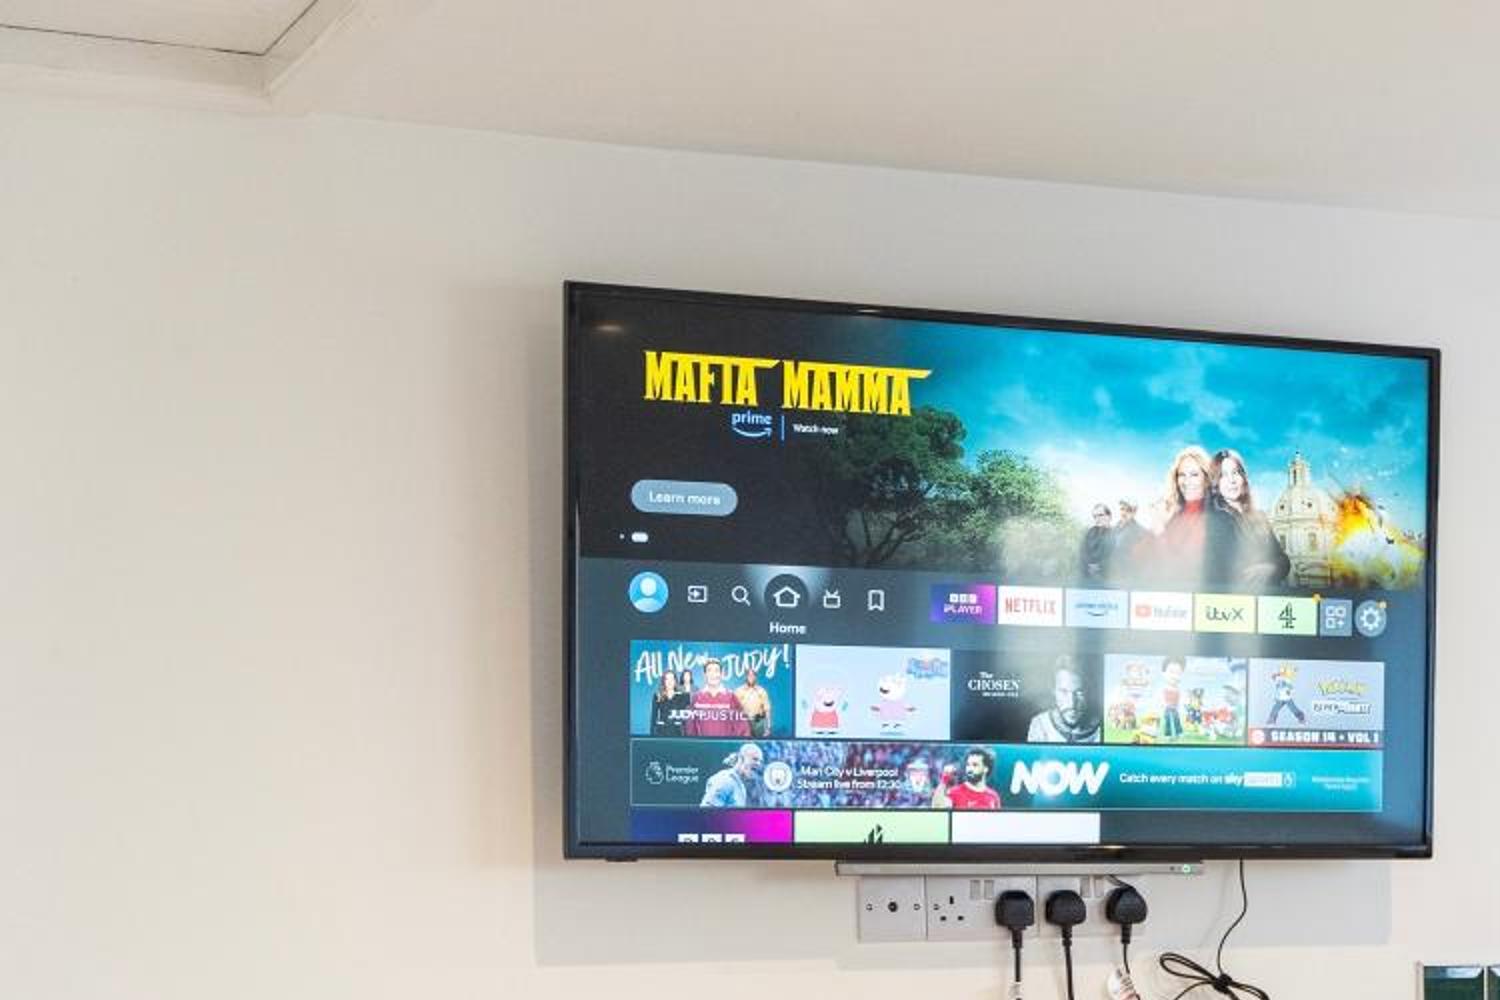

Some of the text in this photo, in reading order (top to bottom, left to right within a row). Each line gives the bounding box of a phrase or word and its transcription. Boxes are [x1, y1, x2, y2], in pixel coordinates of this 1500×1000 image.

[644, 351, 933, 417] MAFIA MAMMA
[732, 410, 772, 425] prime
[649, 490, 721, 506] Learn more
[1005, 597, 1056, 616] NETFLIX
[1205, 605, 1244, 622] itvX
[769, 621, 807, 635] Home
[635, 650, 662, 685] All
[1271, 731, 1319, 743] SEASON
[1347, 731, 1371, 743] VOL
[666, 764, 699, 775] Premier
[801, 766, 823, 775] Man
[825, 766, 845, 779] City
[853, 767, 898, 779] Liverpool
[666, 774, 699, 785] League
[797, 778, 832, 789] Stream
[852, 779, 875, 789] from
[1010, 761, 1110, 795] NOW
[1119, 772, 1148, 783] Catch
[1150, 775, 1176, 785] every
[1178, 773, 1208, 784] match
[1210, 775, 1223, 784] on
